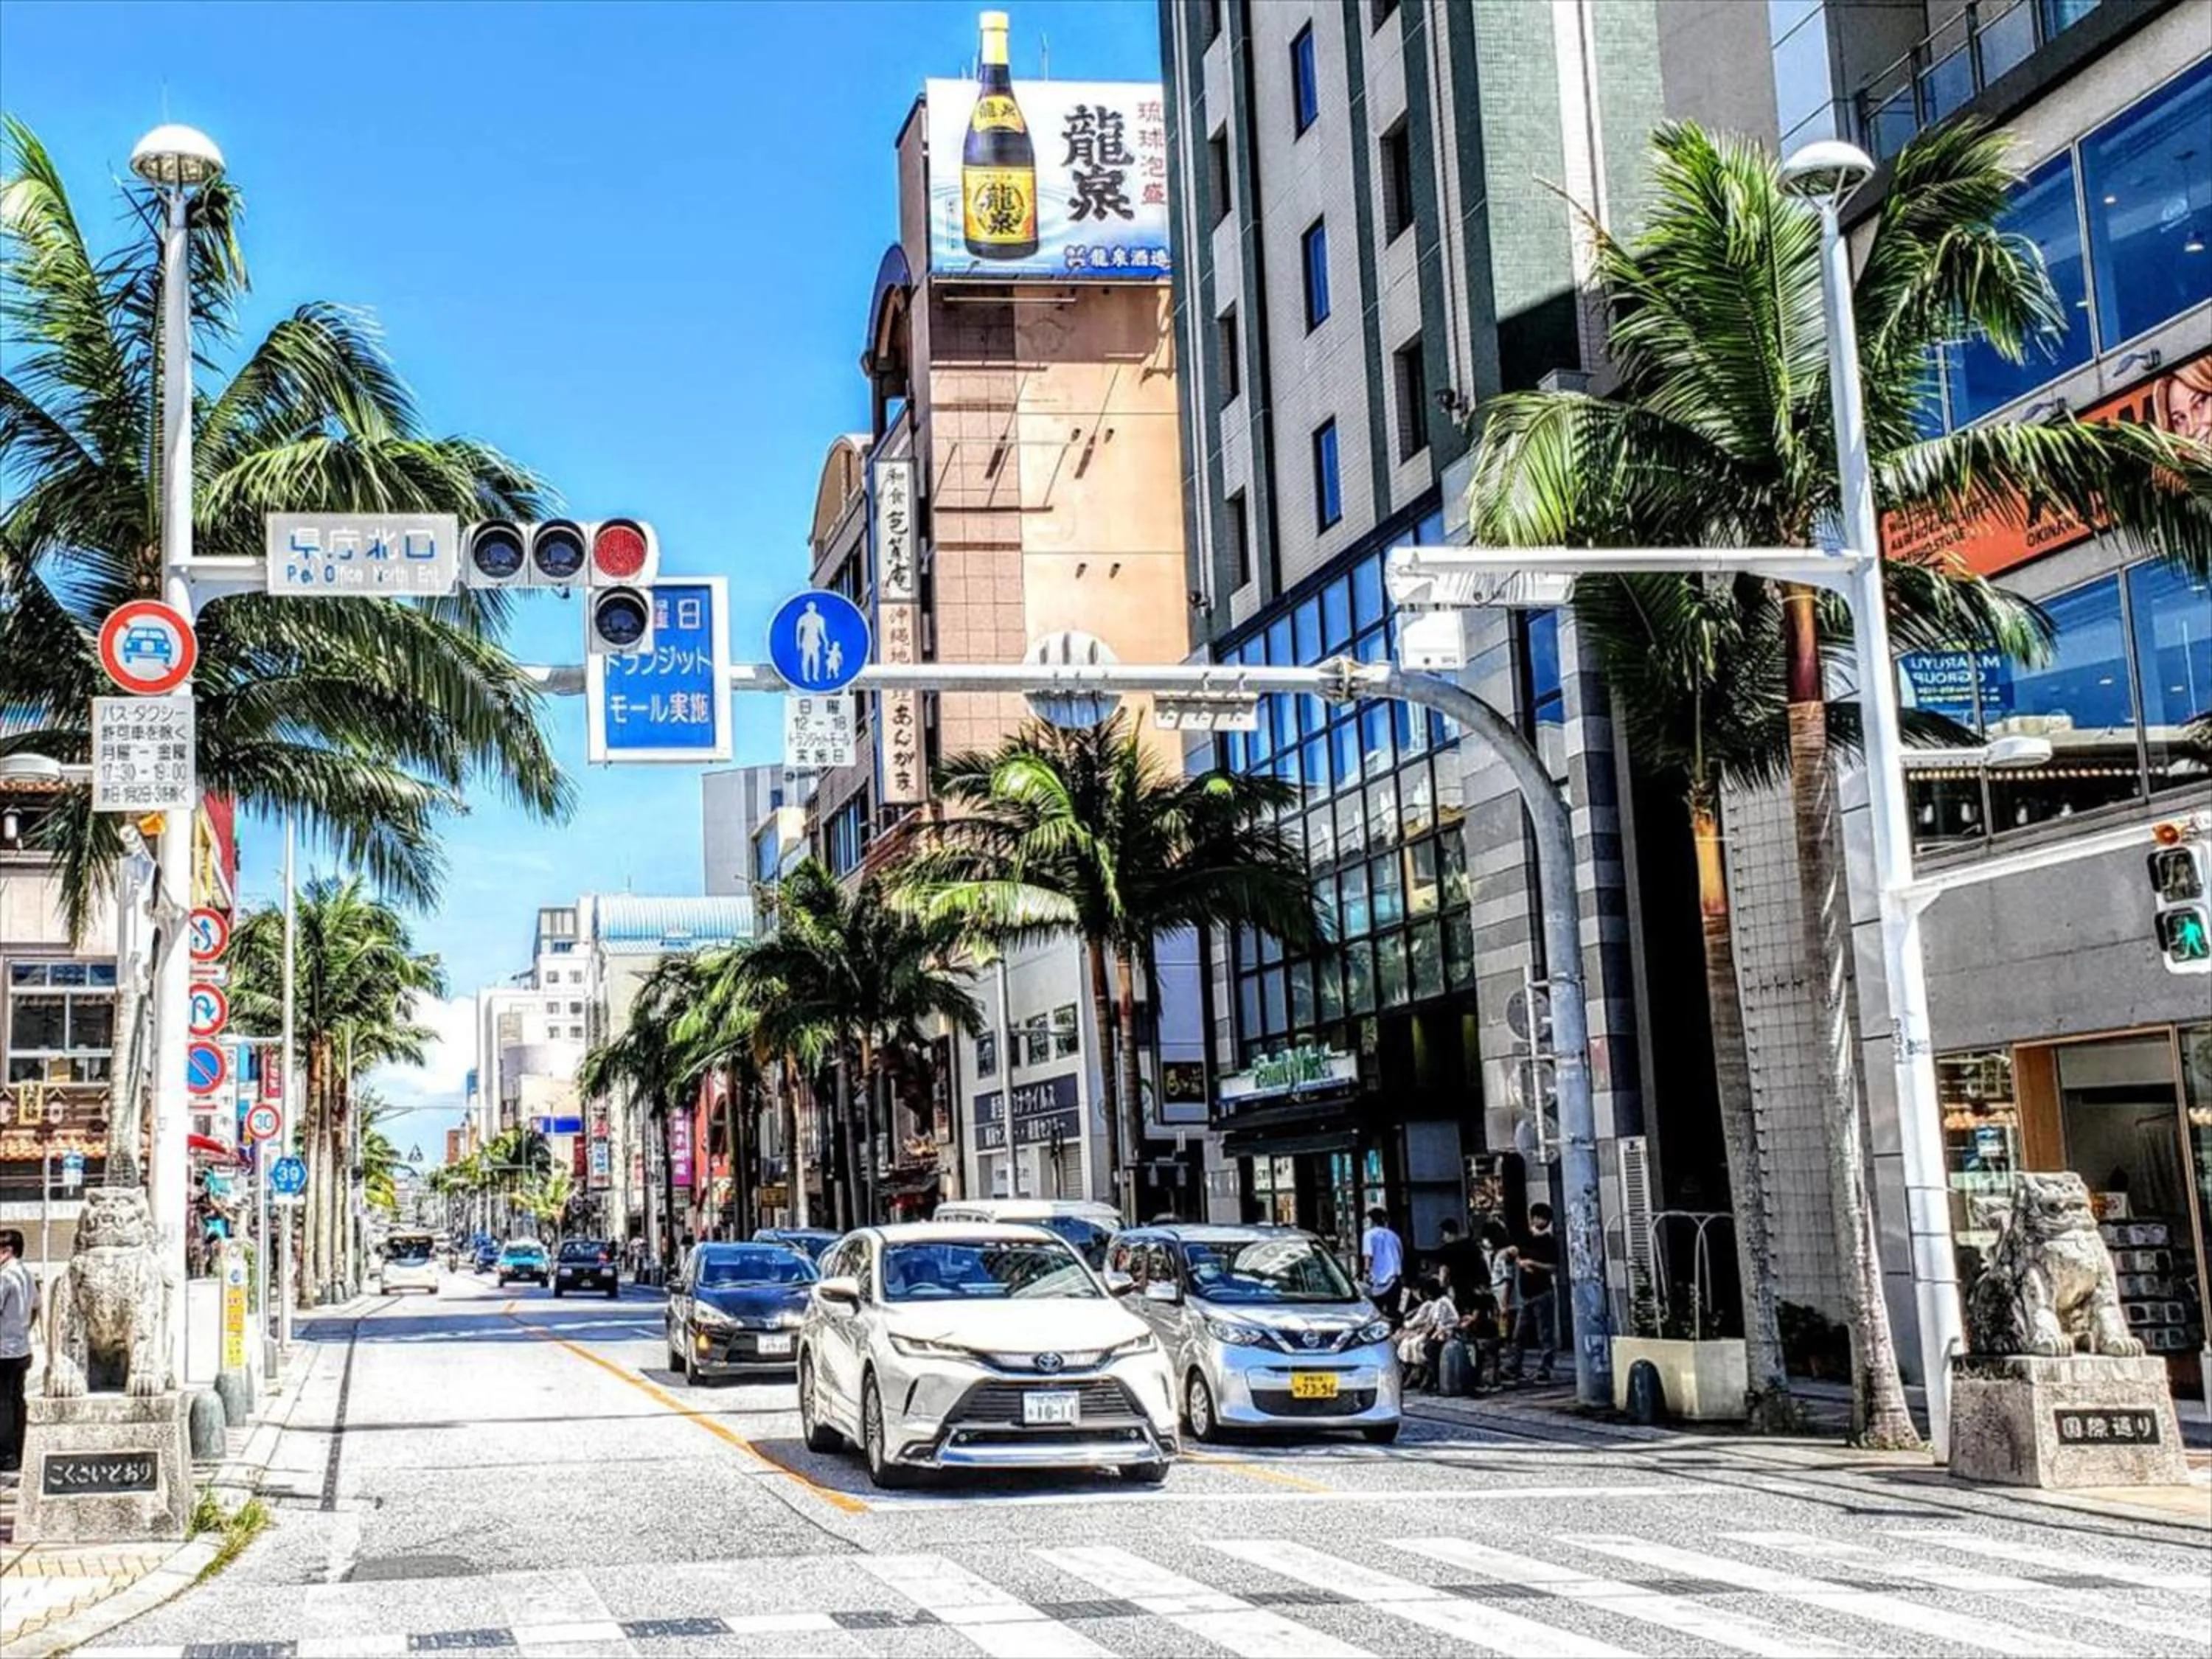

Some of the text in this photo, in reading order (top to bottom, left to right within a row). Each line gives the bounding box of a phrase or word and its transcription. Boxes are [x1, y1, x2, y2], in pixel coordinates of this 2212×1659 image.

[1060, 104, 1135, 223] 龍泉
[1137, 100, 1167, 206] 琉球泡盛
[985, 184, 1017, 236] 龍泉
[290, 526, 436, 561] 県庁北口
[654, 598, 701, 630] 曜日
[605, 646, 712, 677] トランジット
[610, 691, 710, 725] モール実施
[892, 703, 915, 792] あんがま
[254, 1113, 273, 1130] 30
[277, 1165, 299, 1182] 39
[2062, 1416, 2152, 1439] 国際通り
[49, 1462, 151, 1485] こくさいとおり
